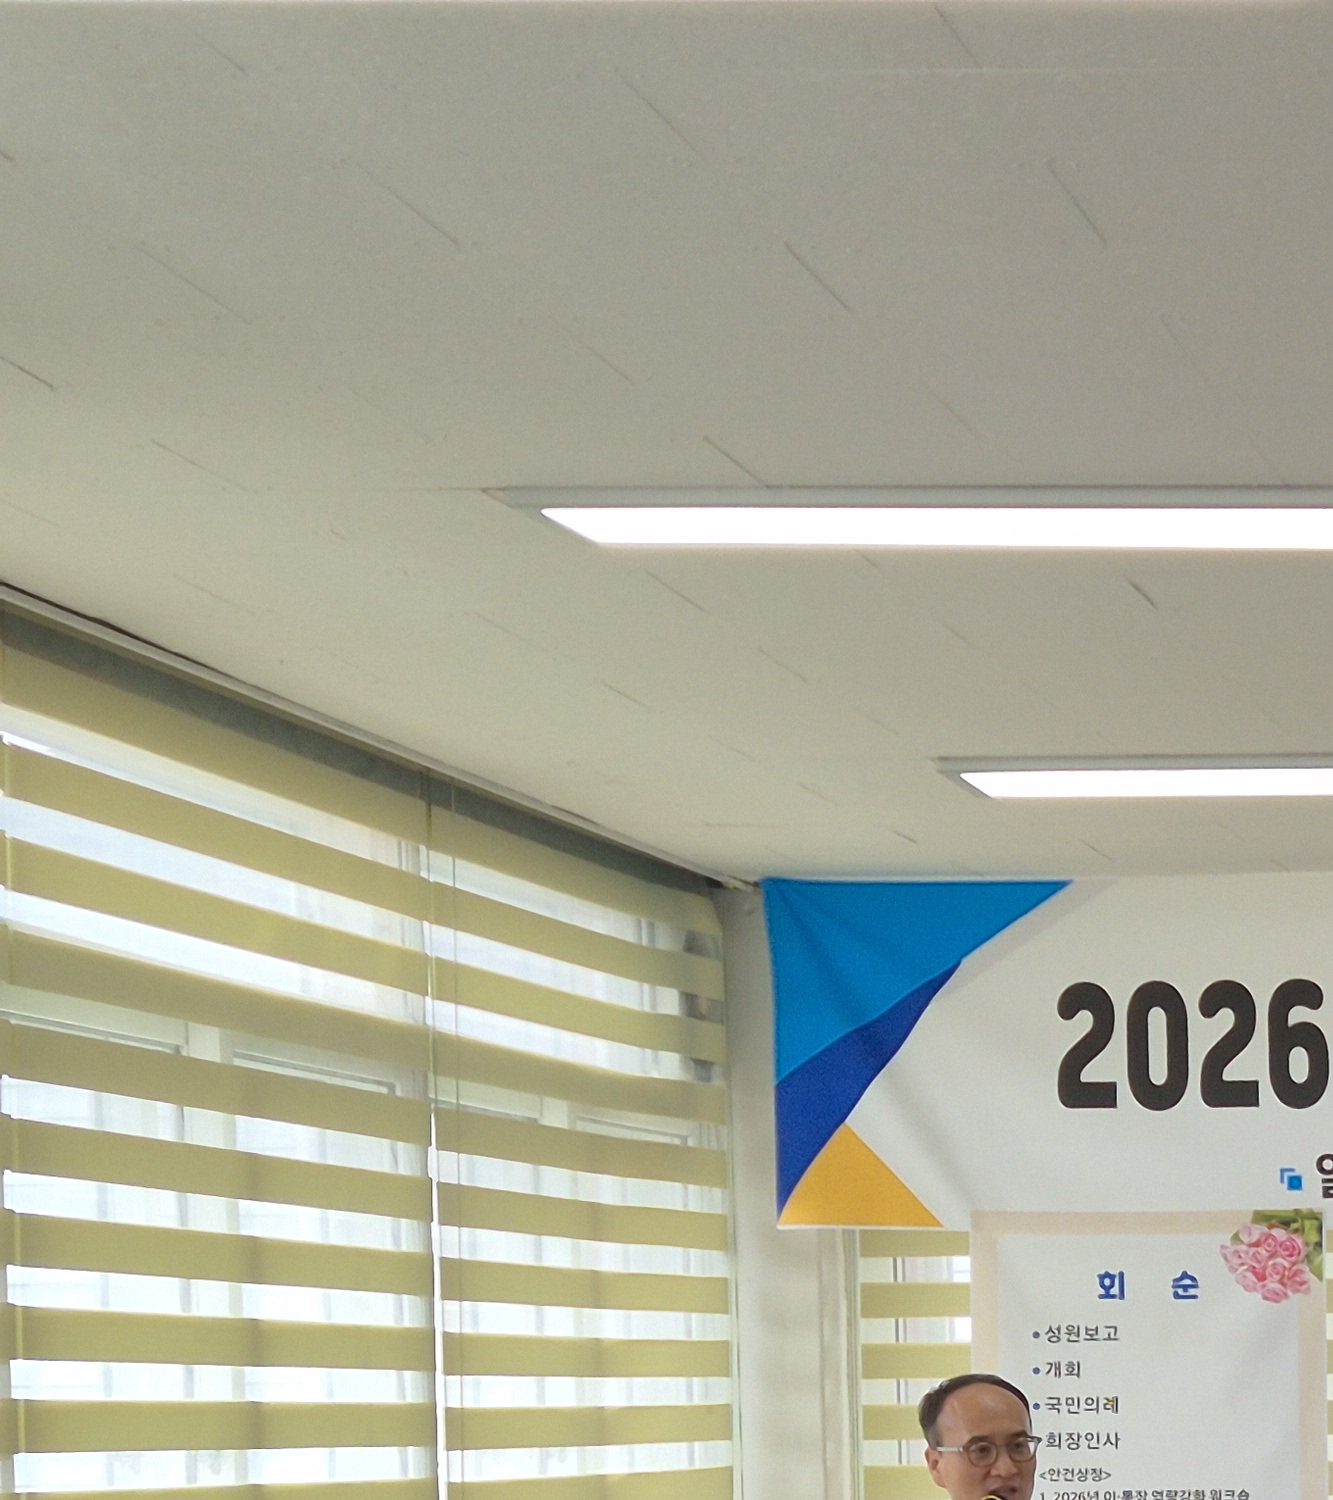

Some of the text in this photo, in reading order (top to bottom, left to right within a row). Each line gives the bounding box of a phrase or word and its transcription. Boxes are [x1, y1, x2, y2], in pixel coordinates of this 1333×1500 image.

[1044, 1324, 1119, 1344] 성원보고
[1045, 1360, 1081, 1379] 개회
[1044, 1395, 1119, 1415] 국민의례
[1045, 1431, 1121, 1451] 회장인사
